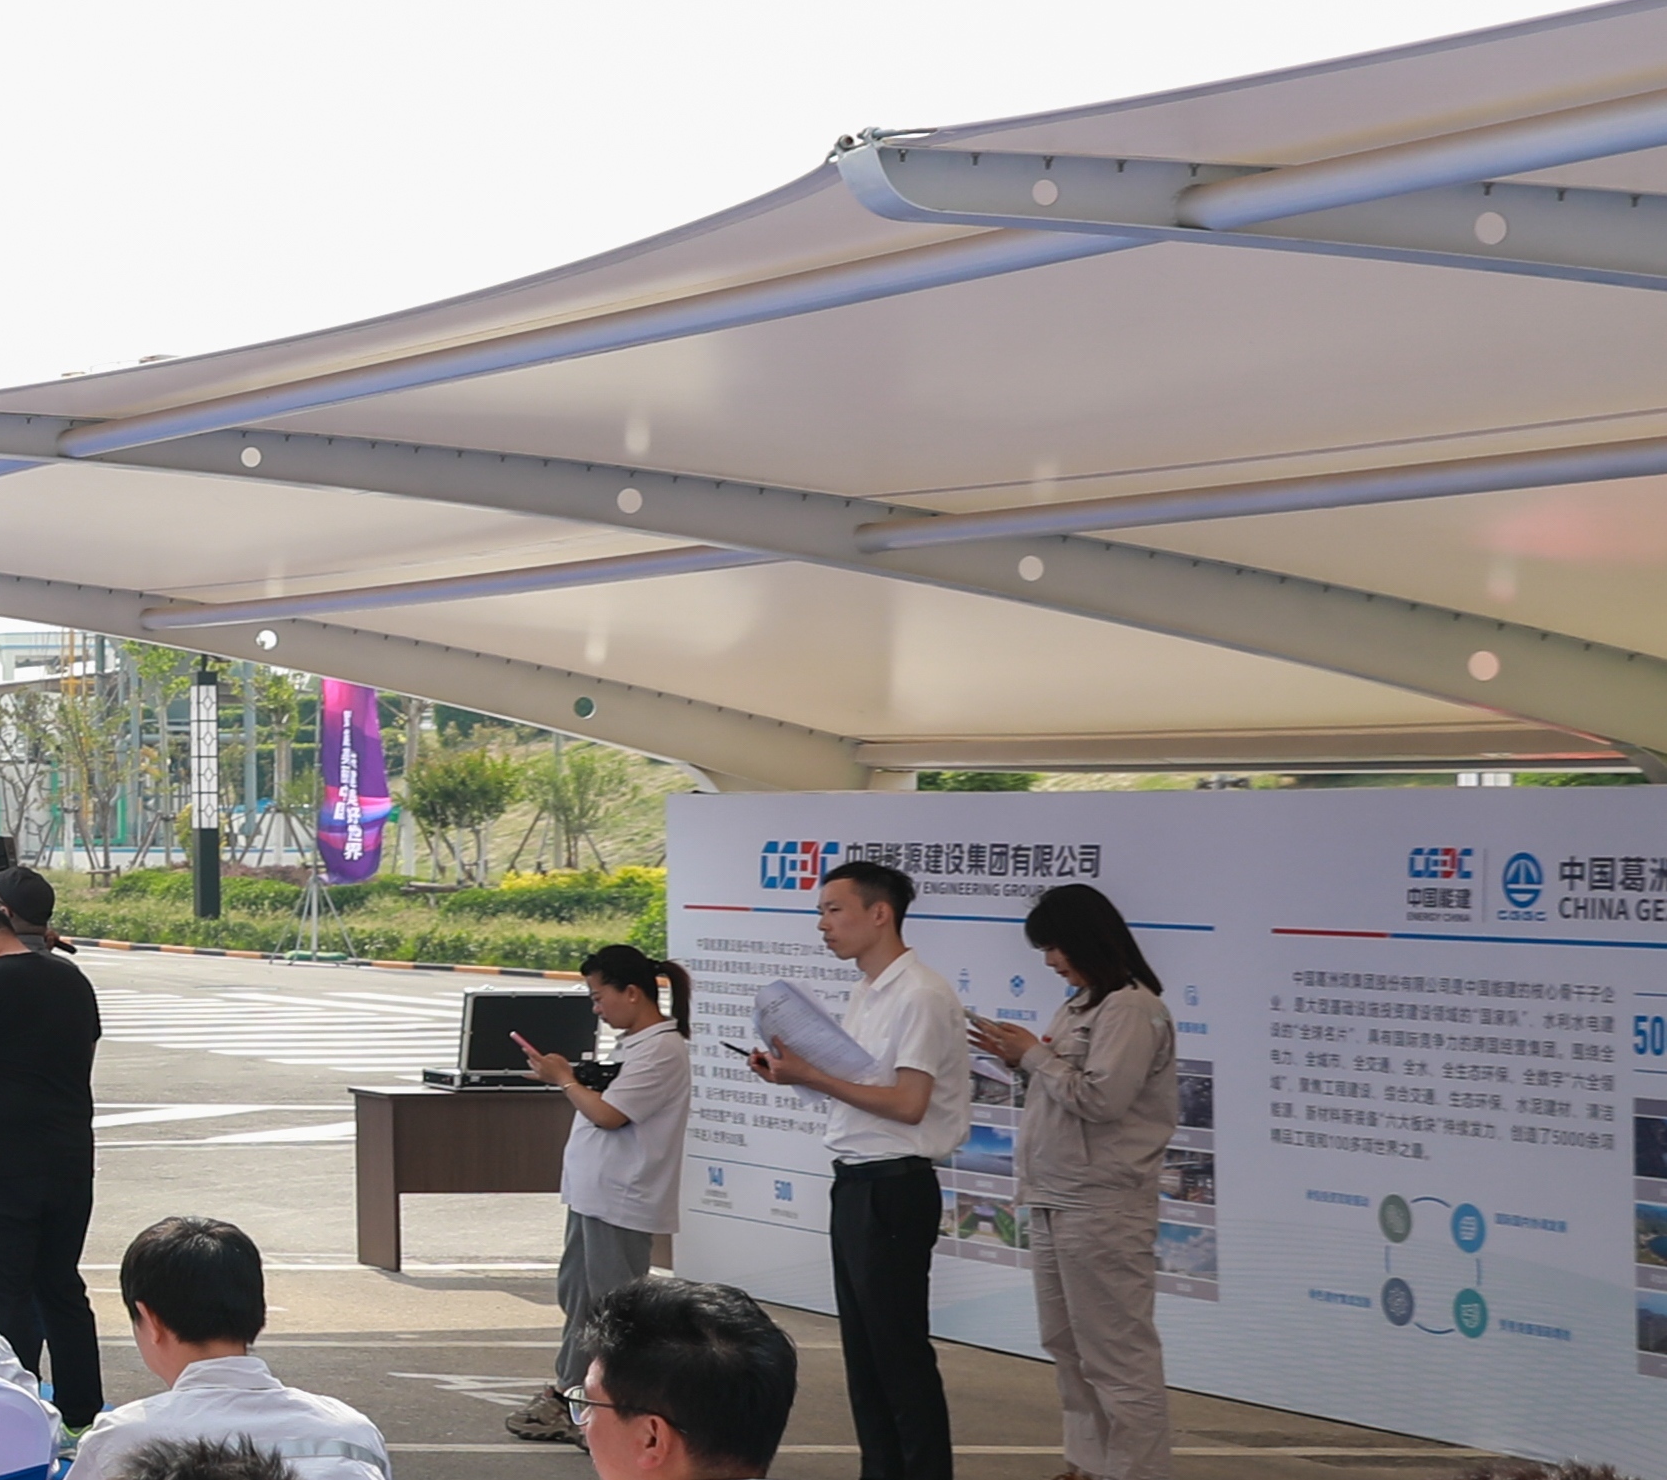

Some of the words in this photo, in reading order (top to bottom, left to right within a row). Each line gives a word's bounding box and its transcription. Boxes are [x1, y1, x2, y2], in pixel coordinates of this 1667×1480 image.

[923, 881, 1000, 897] ENGINEERING
[1406, 887, 1472, 909] 中国能建
[1558, 897, 1632, 921] CHINA
